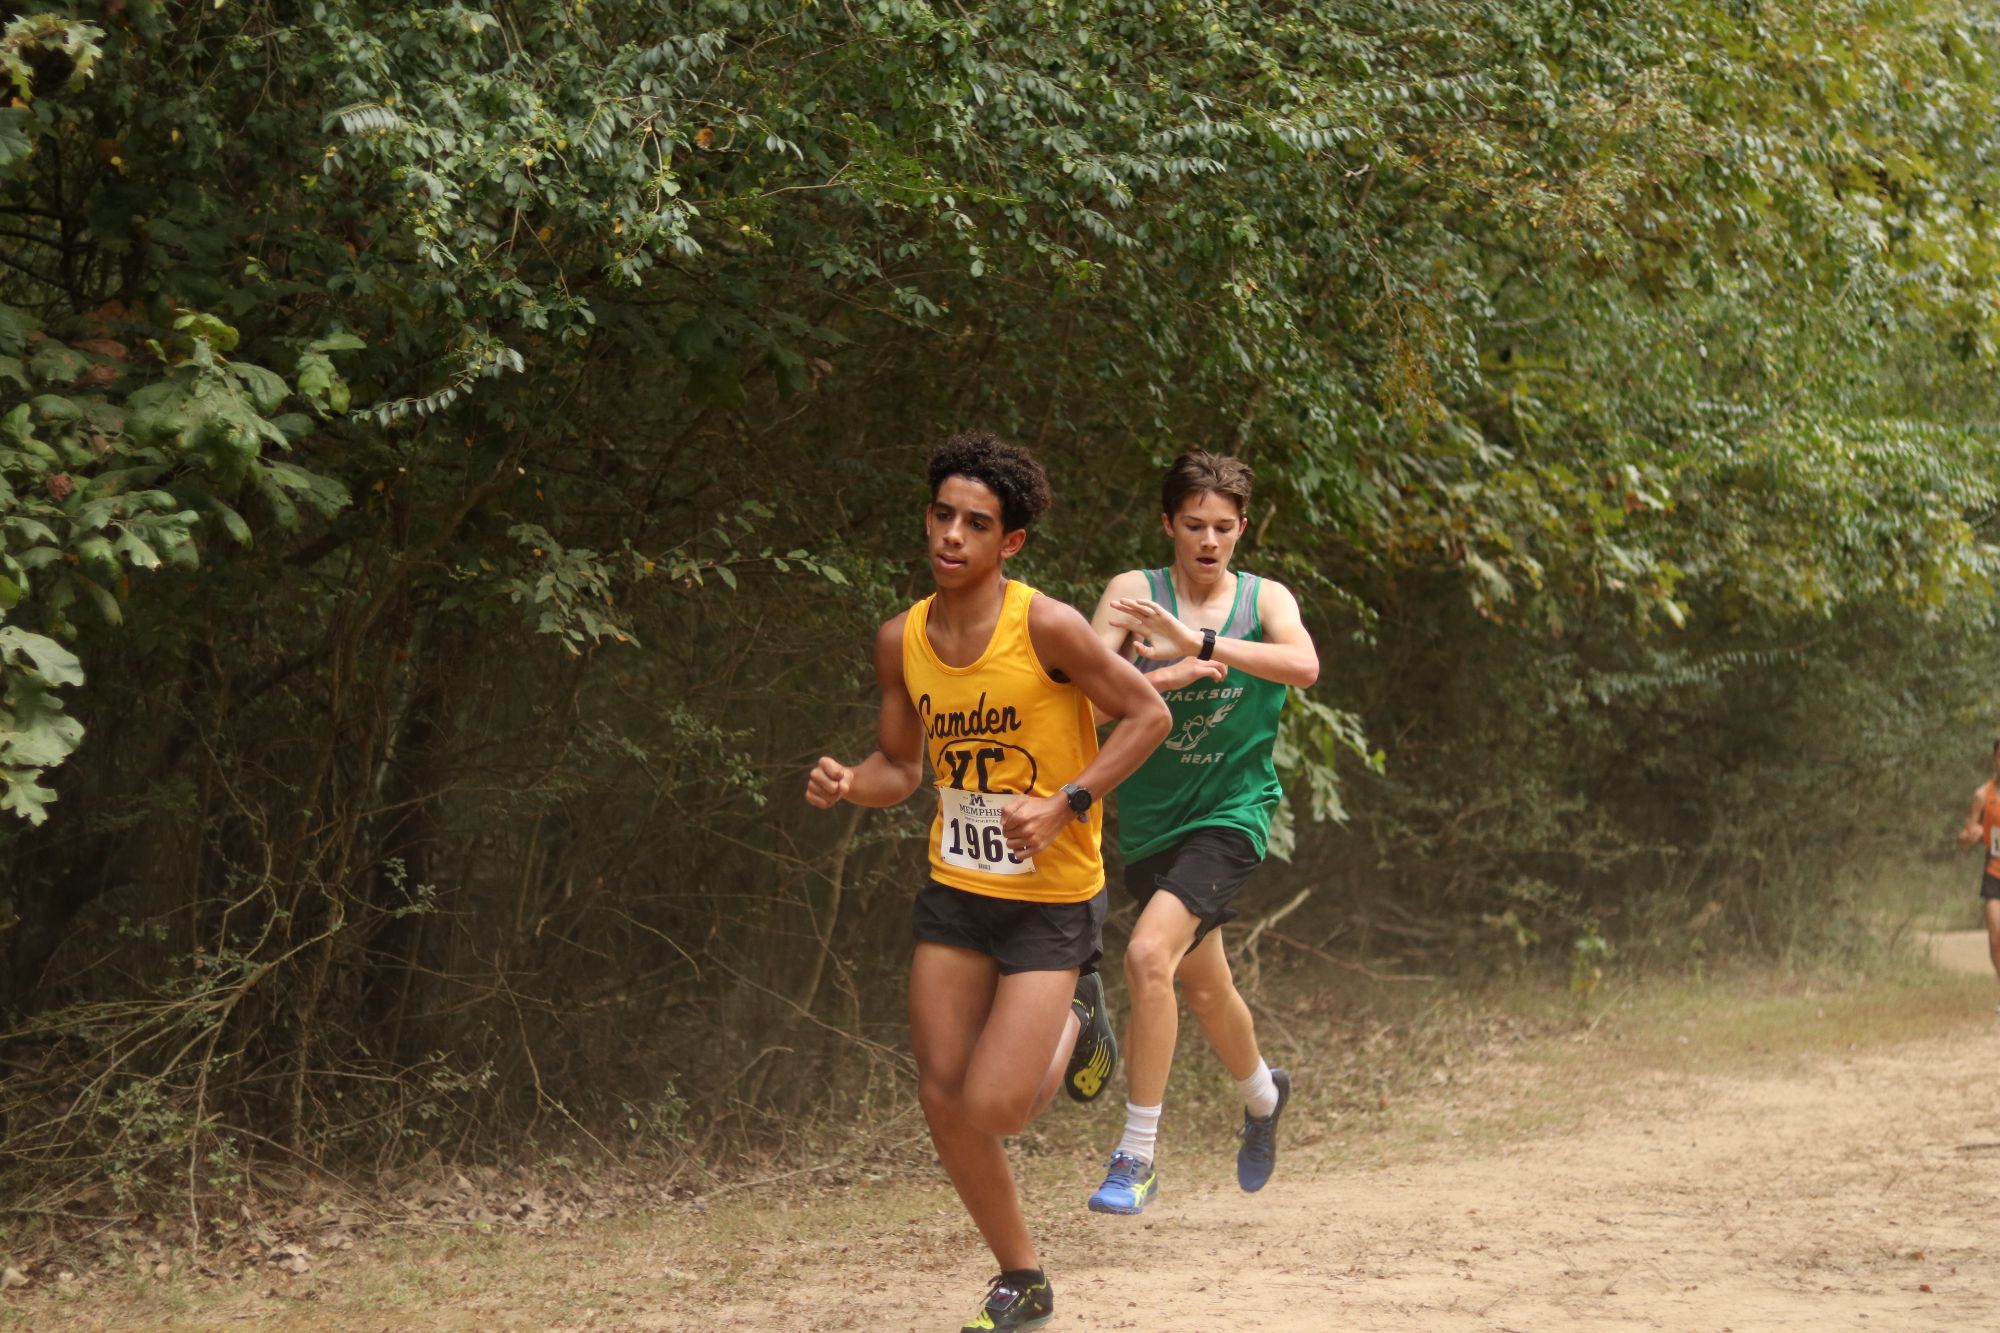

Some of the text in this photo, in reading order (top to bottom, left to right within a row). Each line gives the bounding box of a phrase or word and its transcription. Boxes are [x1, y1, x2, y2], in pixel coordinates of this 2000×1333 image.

[1164, 687, 1243, 702] JACKSON
[919, 692, 1021, 739] Camden
[1180, 752, 1224, 764] HEAT
[969, 793, 986, 807] M
[960, 804, 1003, 816] MEMPHIS
